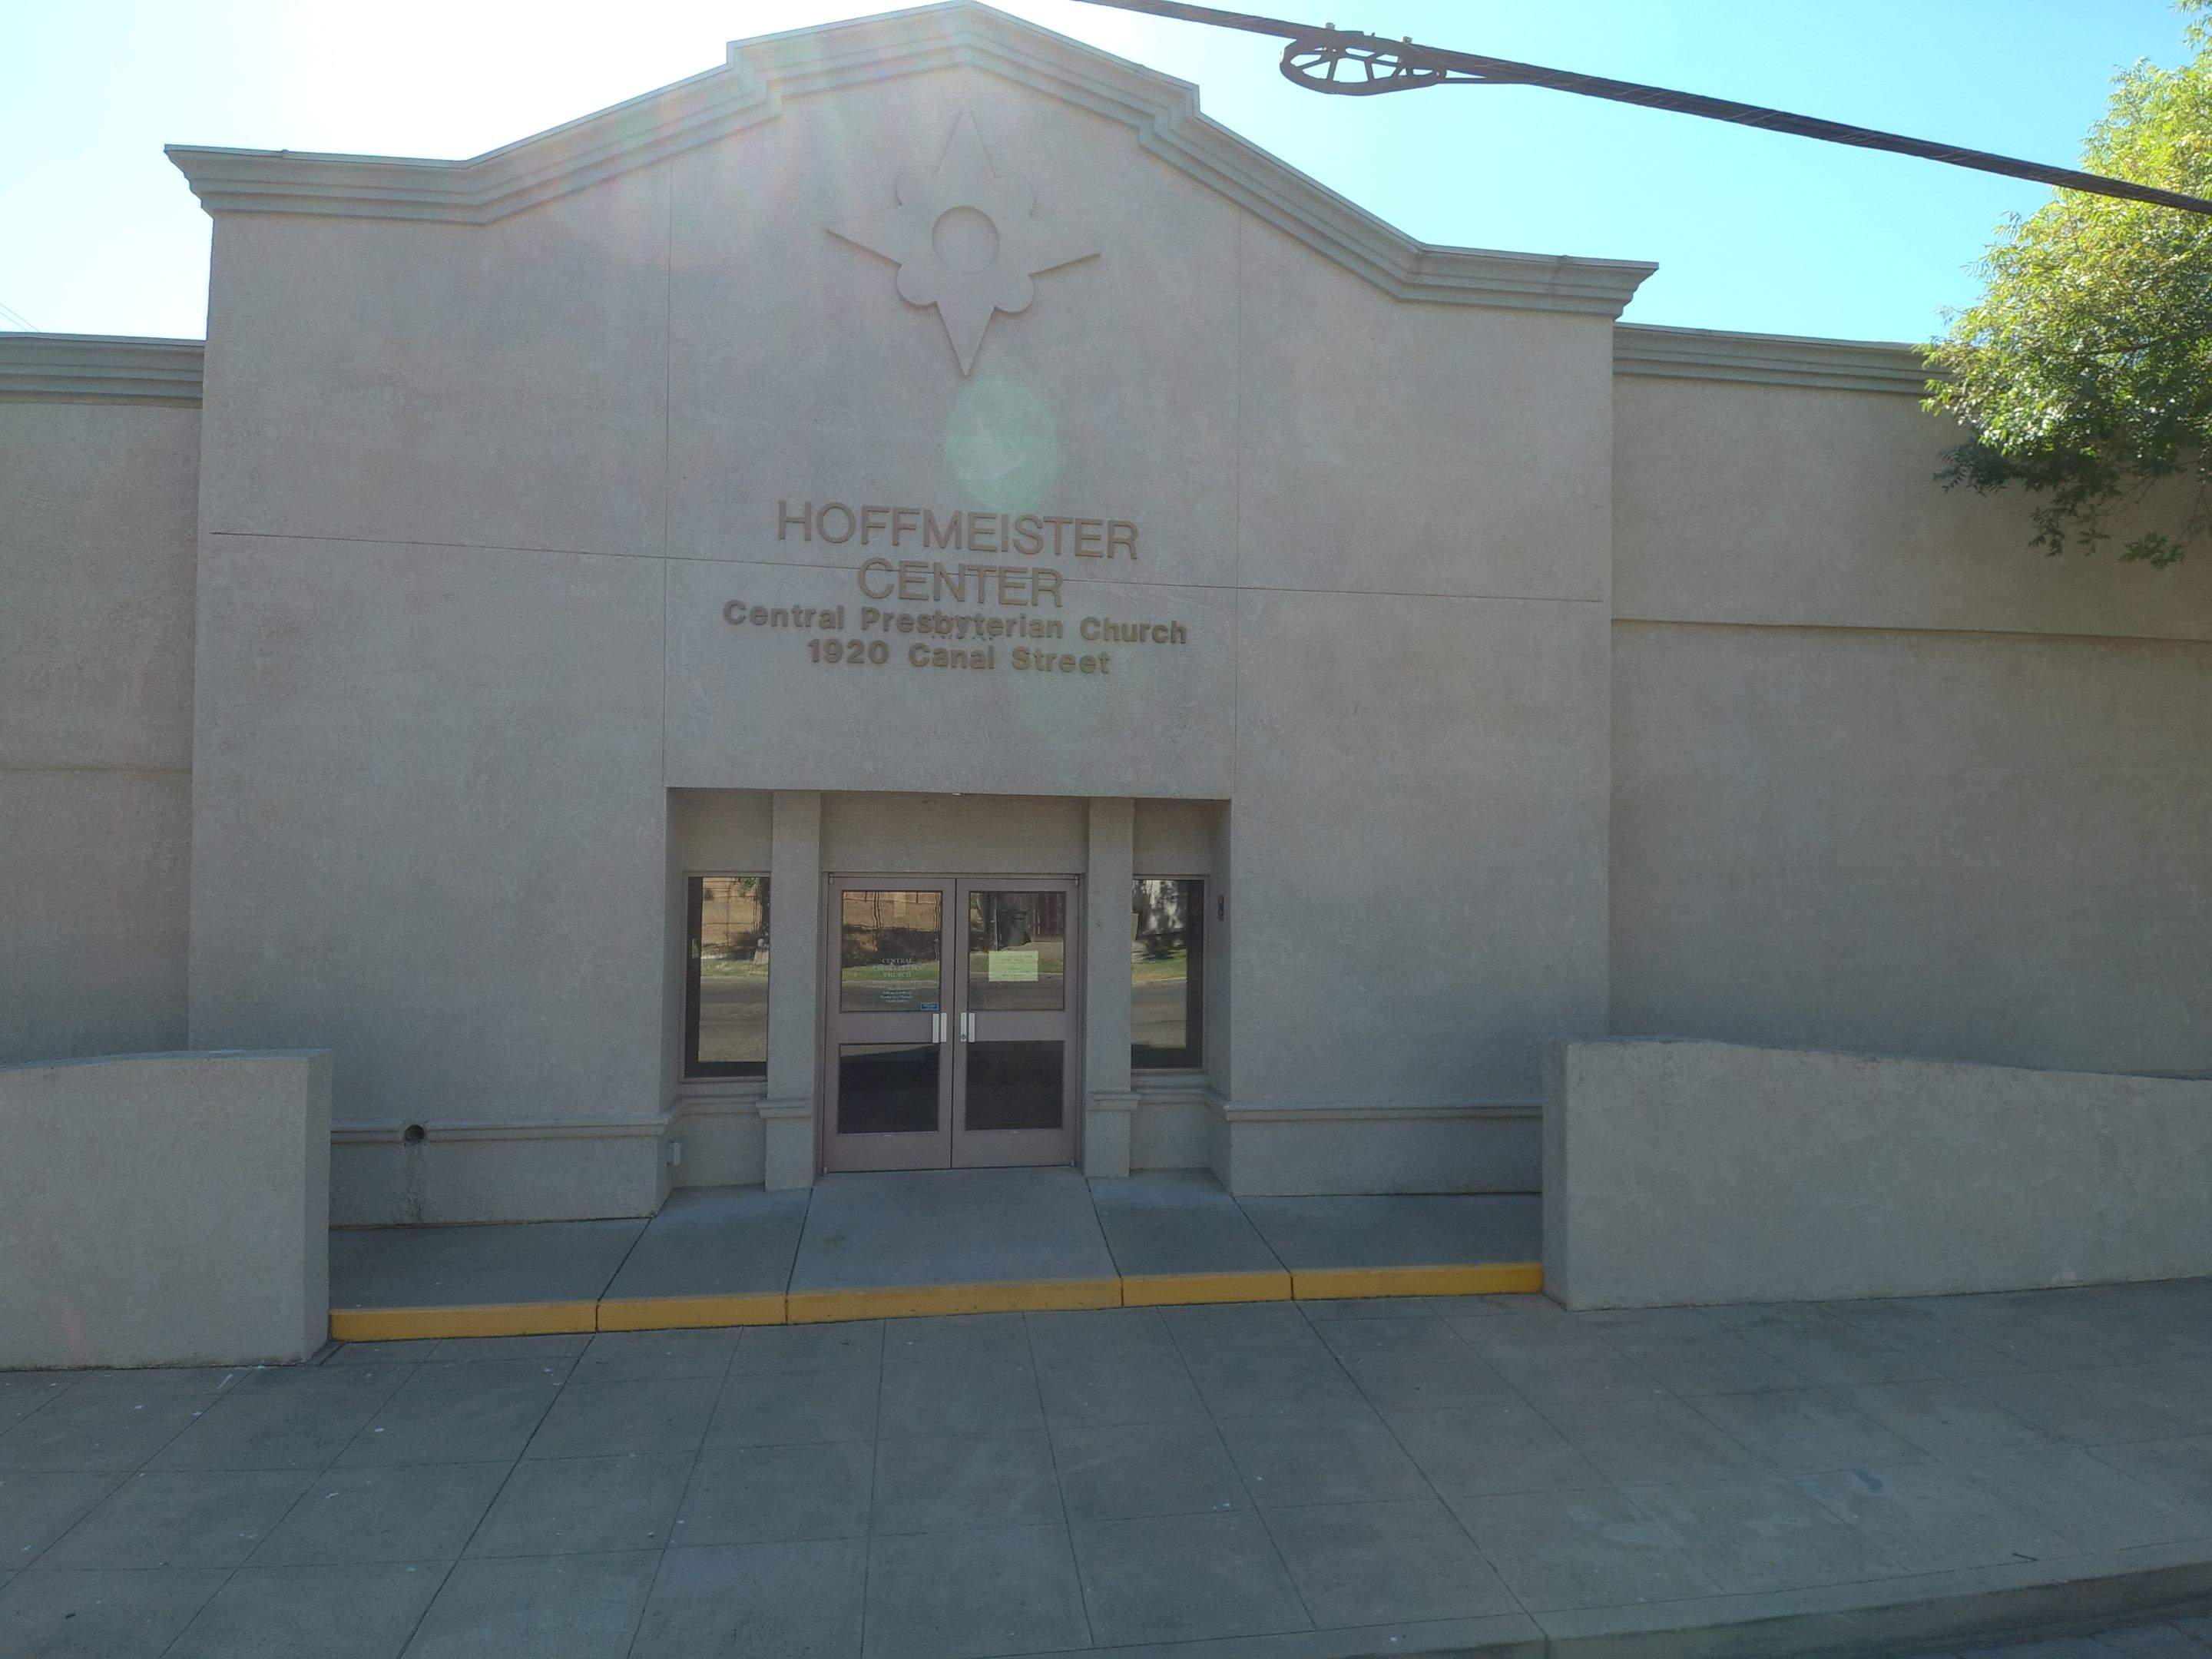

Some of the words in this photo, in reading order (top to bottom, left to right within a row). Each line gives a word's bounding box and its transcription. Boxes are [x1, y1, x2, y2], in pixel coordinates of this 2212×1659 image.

[778, 500, 1139, 560] HOFFMEISTER
[858, 558, 1063, 608] CENTER
[724, 599, 845, 630] Central
[861, 607, 1064, 639] Presbyterian
[1080, 617, 1187, 644] Church
[809, 638, 889, 664] 1920
[909, 643, 995, 670] Canal
[1012, 647, 1111, 674] Street
